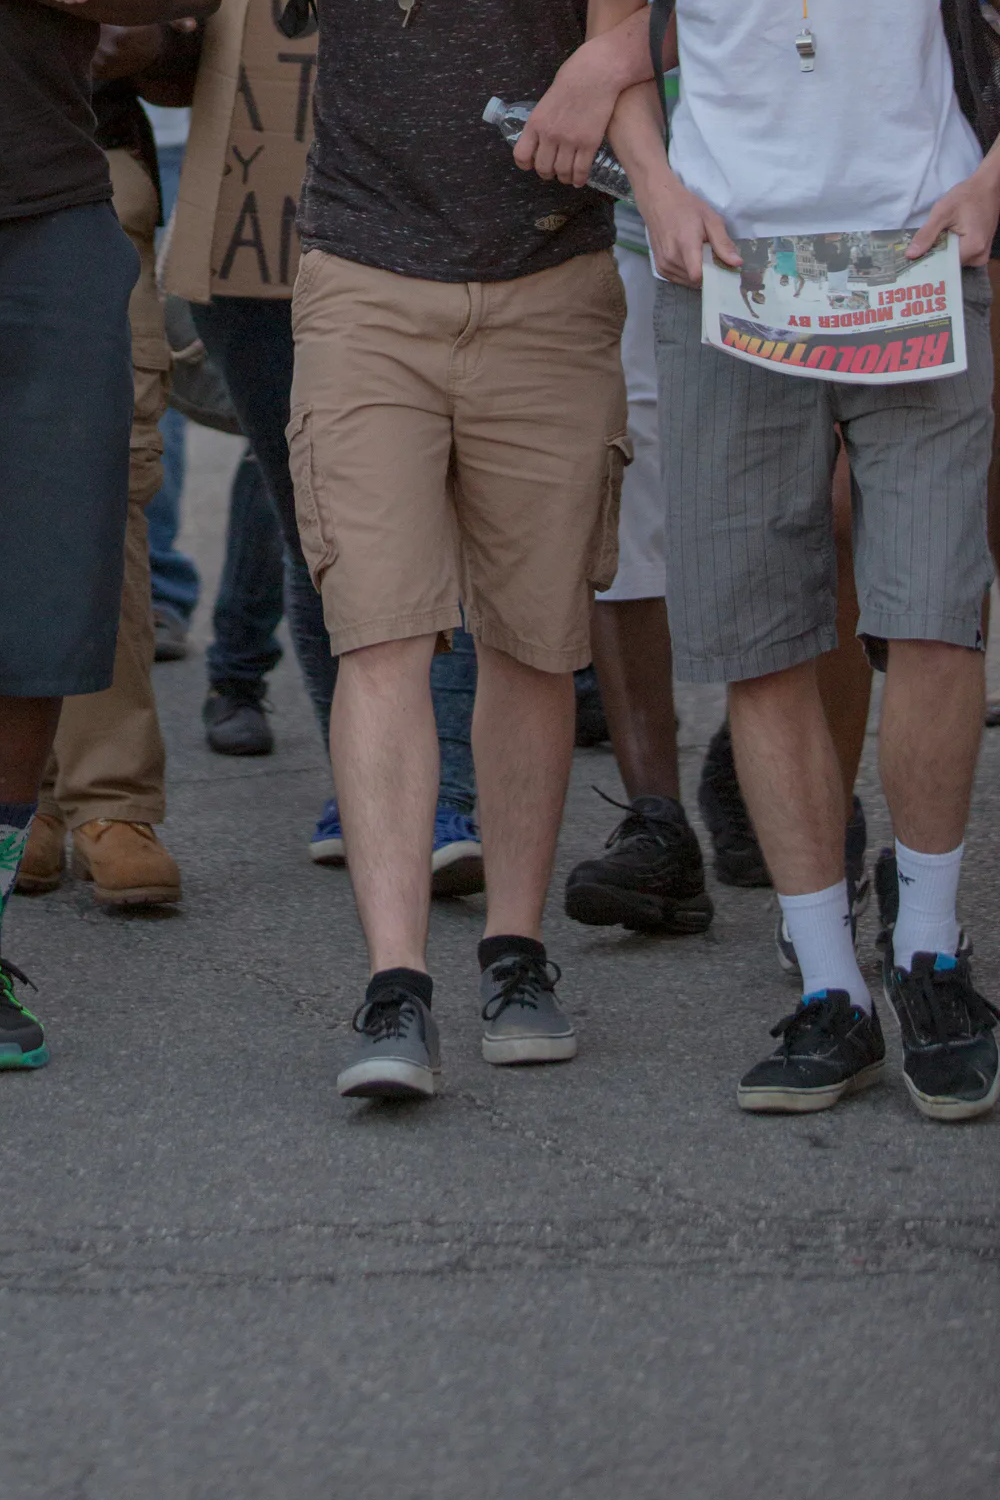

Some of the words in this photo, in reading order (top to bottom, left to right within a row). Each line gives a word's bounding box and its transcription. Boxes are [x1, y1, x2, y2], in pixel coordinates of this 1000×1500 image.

[877, 280, 946, 307] POLICE!
[819, 306, 893, 328] MURDER
[900, 296, 947, 318] STOP
[788, 314, 811, 328] BY
[722, 327, 951, 374] REVOLUTION
